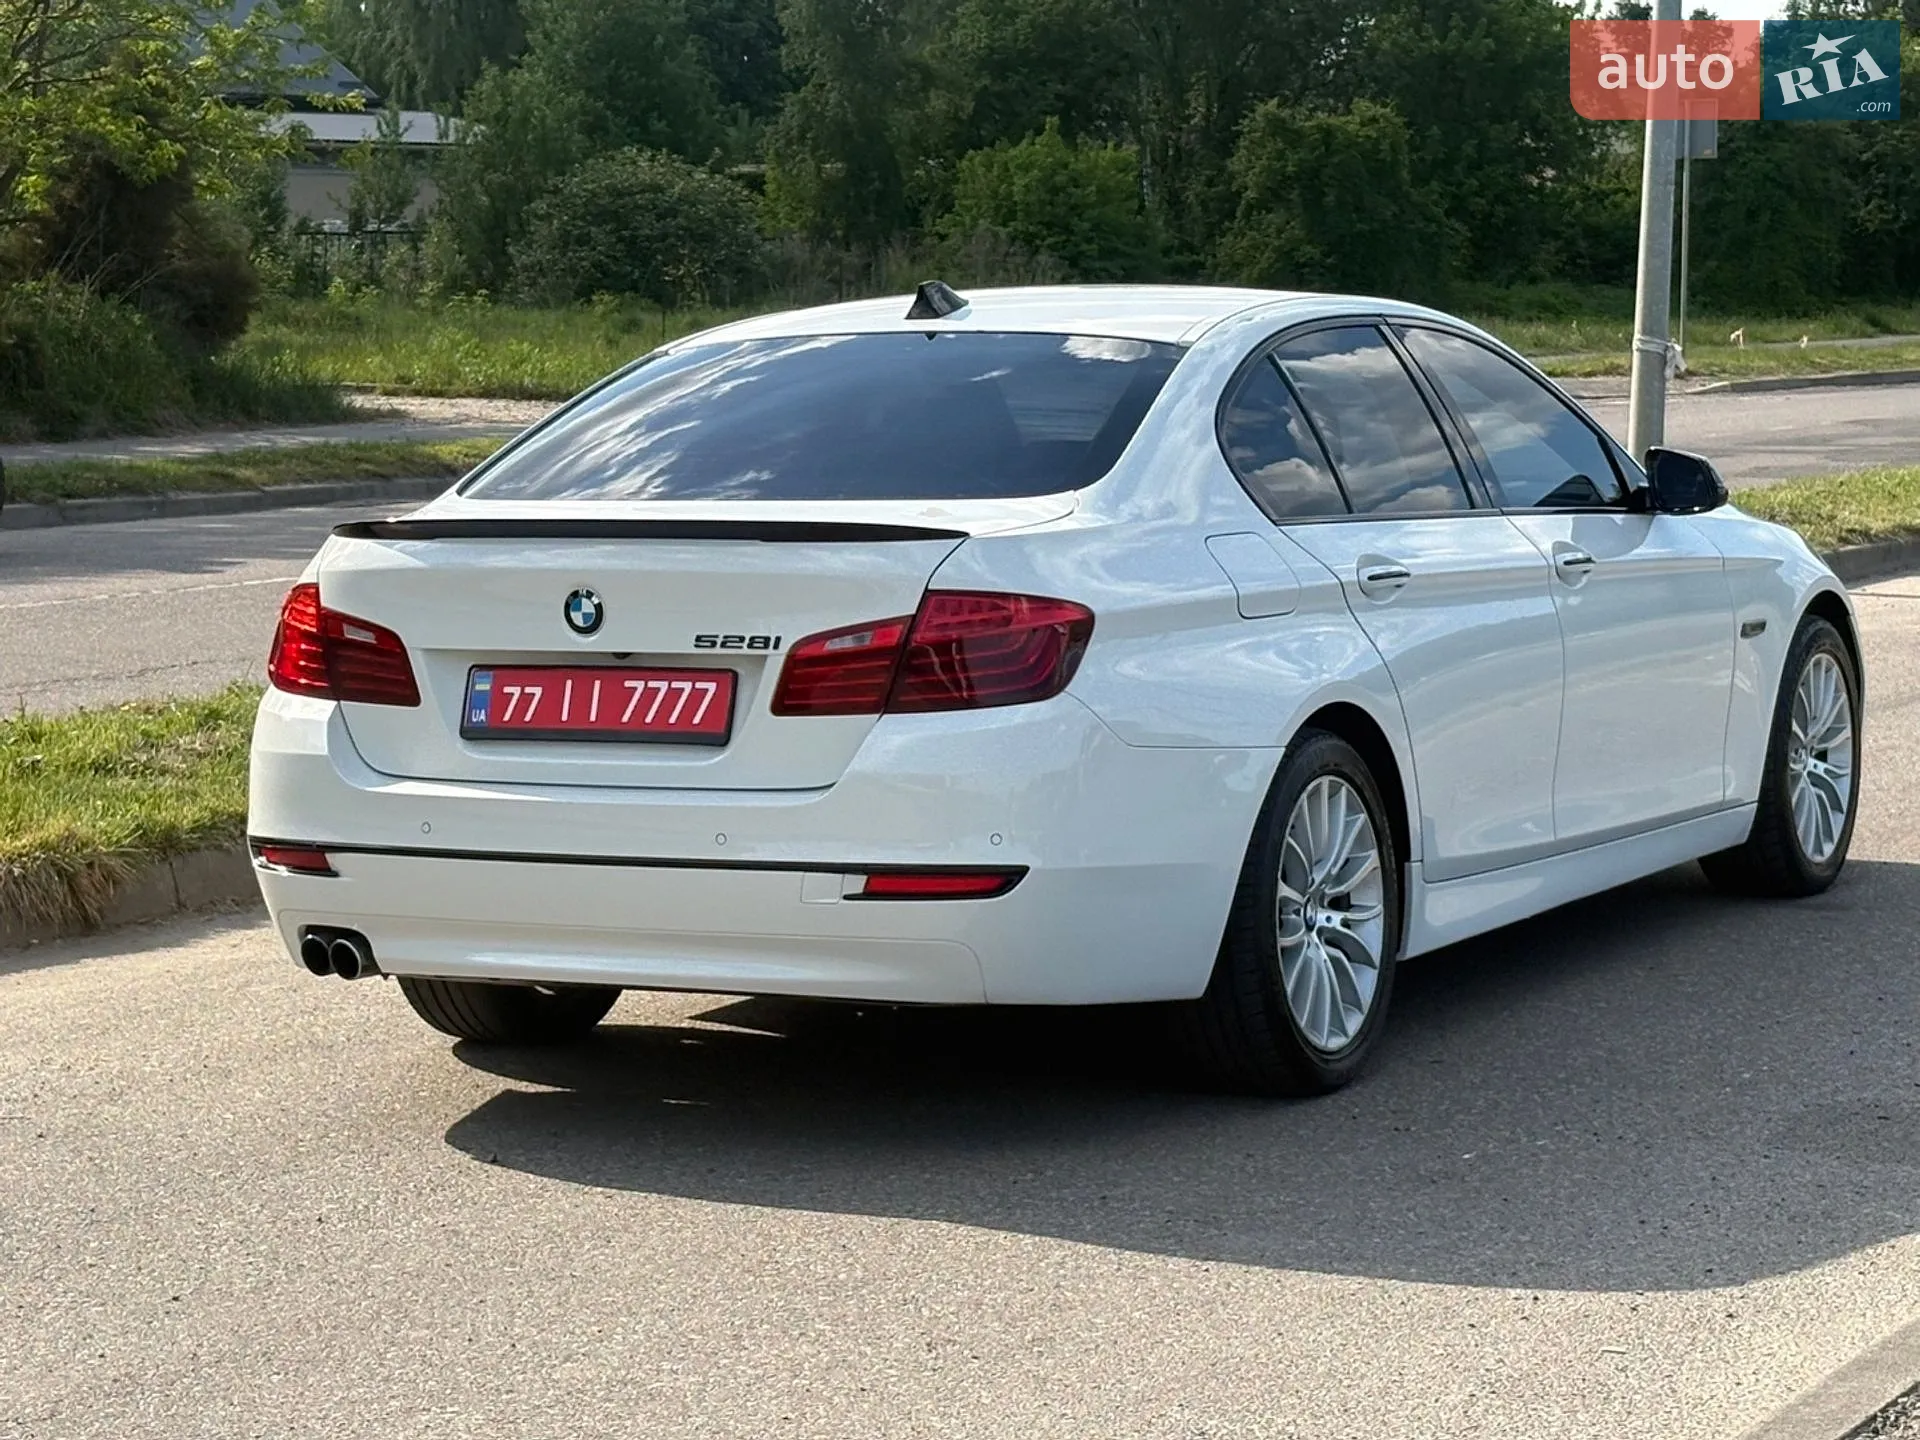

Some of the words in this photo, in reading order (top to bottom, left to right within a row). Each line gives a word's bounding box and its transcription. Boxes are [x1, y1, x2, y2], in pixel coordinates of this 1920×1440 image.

[471, 708, 486, 723] UA
[502, 686, 543, 722] 77
[620, 680, 717, 725] 7777
